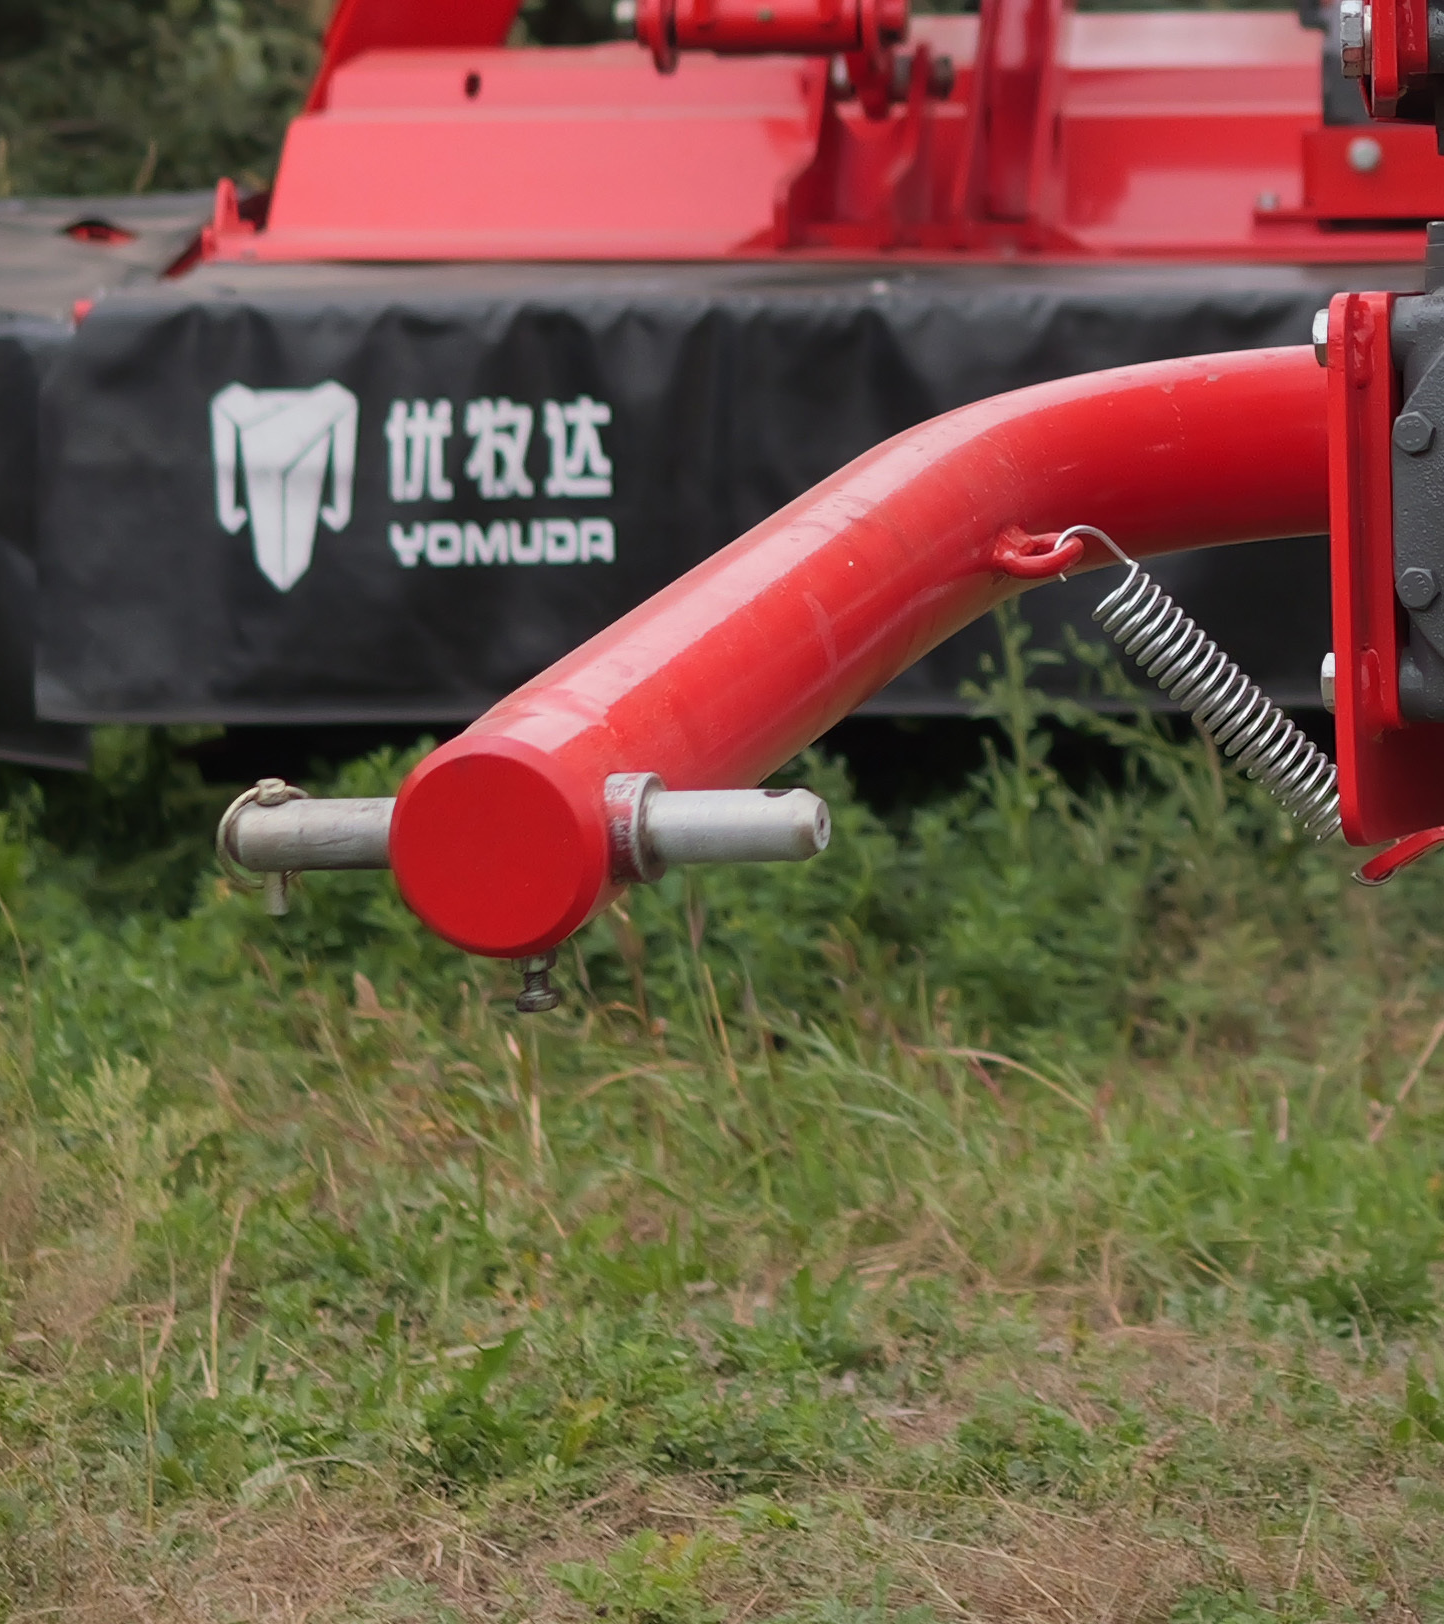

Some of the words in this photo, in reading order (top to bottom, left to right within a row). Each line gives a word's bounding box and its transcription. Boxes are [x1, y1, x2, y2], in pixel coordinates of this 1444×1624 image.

[385, 394, 613, 503] 优牧达
[388, 516, 616, 568] YOMUDA
